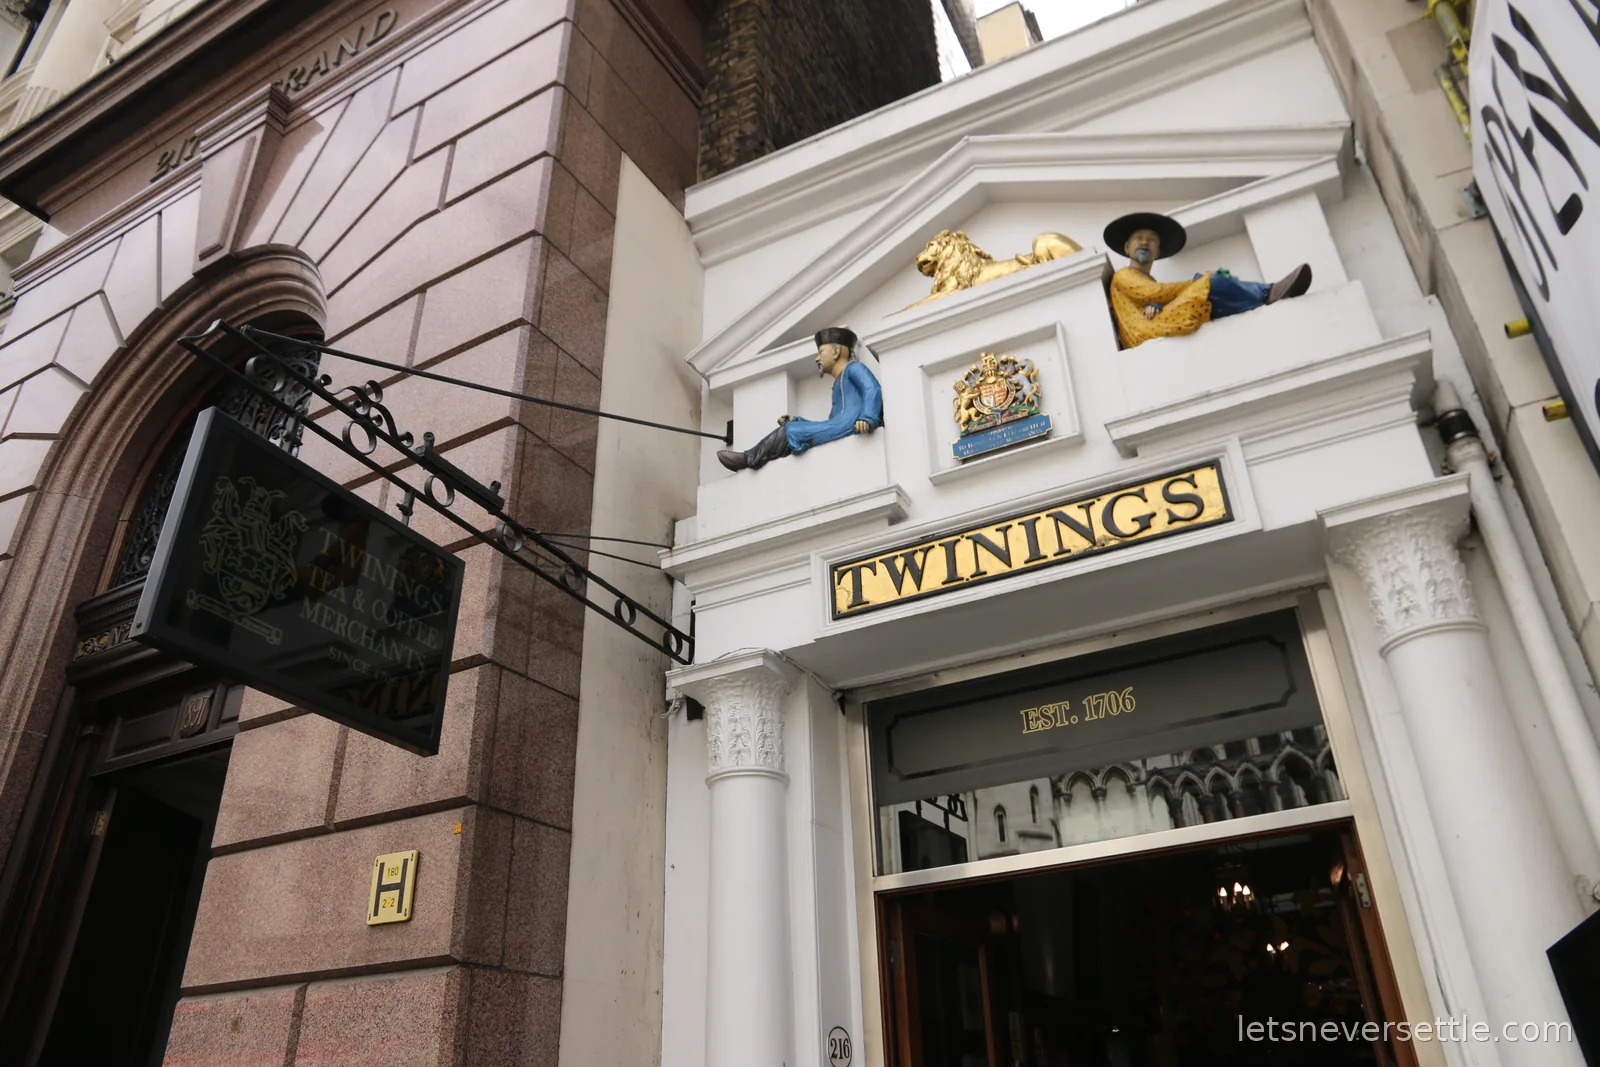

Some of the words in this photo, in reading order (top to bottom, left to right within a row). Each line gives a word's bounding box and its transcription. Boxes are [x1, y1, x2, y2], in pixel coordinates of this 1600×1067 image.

[273, 8, 399, 94] RAND
[319, 527, 443, 616] TWININGS
[837, 473, 1205, 610] TWININGS
[299, 596, 427, 674] MERCHANTS
[308, 564, 347, 604] TEA
[352, 588, 366, 613] &
[371, 598, 439, 650] COFFEE
[328, 646, 372, 676] SINCE
[1020, 701, 1078, 734] EST.
[1082, 686, 1136, 722] 1706
[373, 858, 409, 917] H
[830, 1037, 850, 1060] 216
